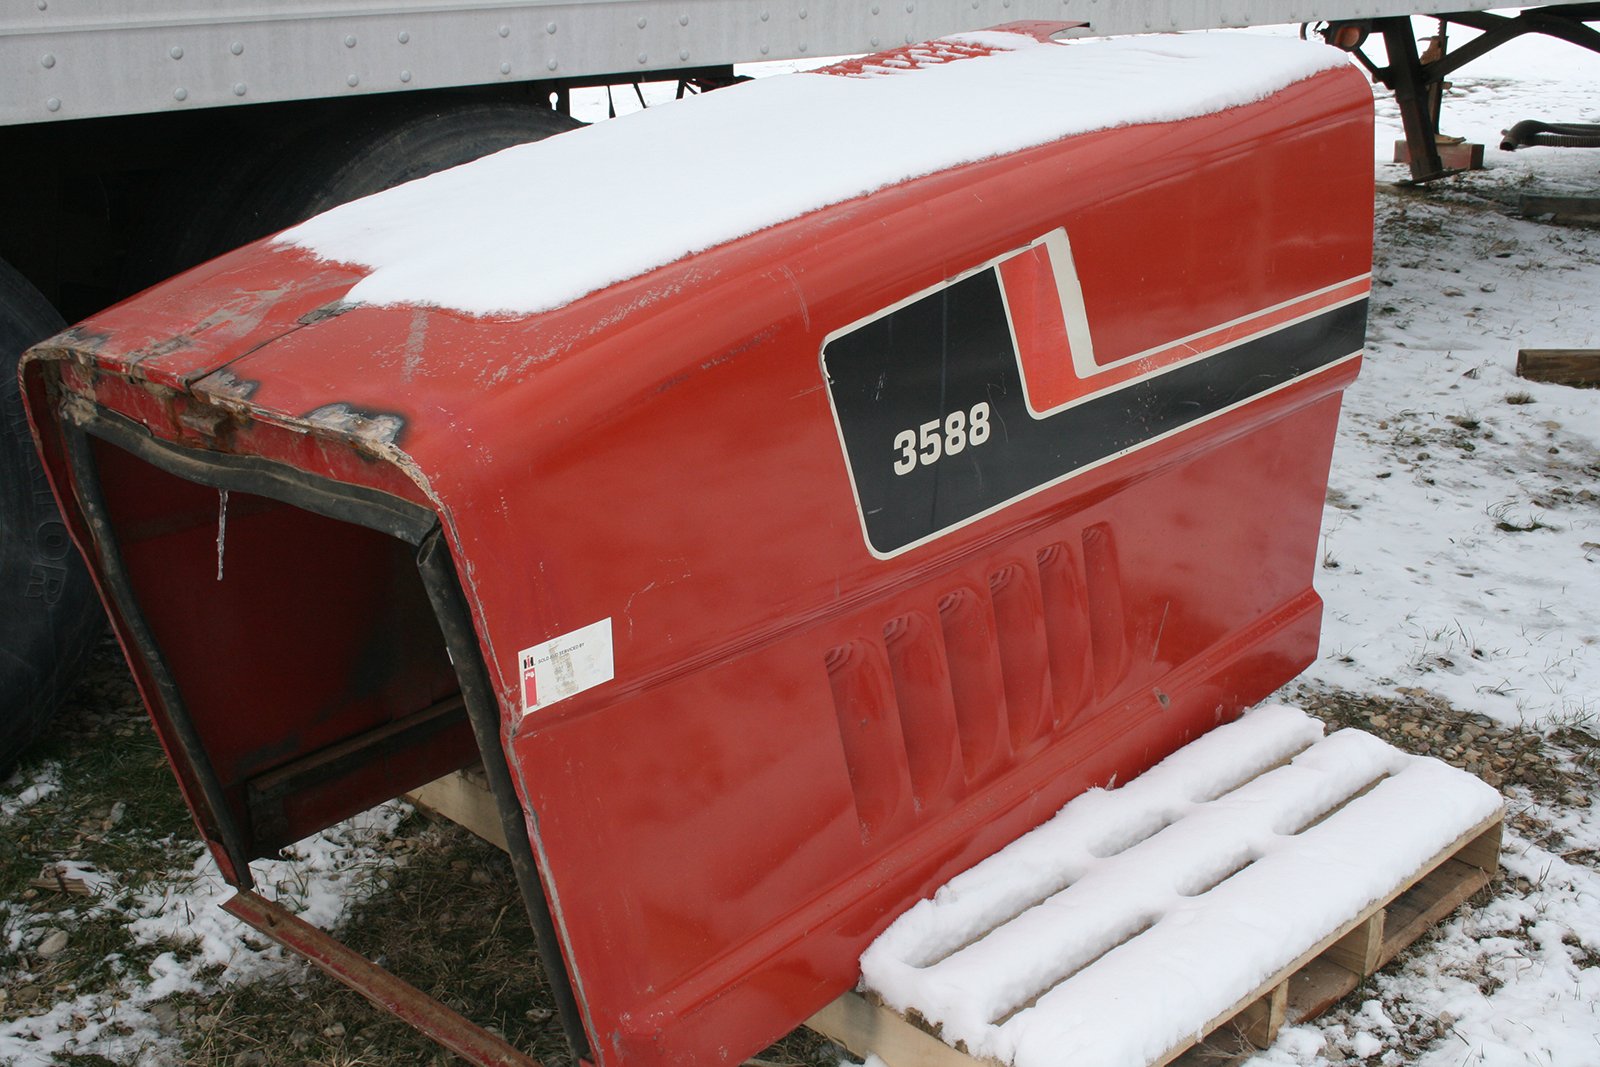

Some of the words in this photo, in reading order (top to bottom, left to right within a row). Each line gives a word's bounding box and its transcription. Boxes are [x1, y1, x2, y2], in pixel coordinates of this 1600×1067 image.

[893, 401, 991, 476] 3588
[538, 655, 549, 664] SOLD
[549, 652, 558, 660] AND
[559, 645, 579, 656] SERVICED
